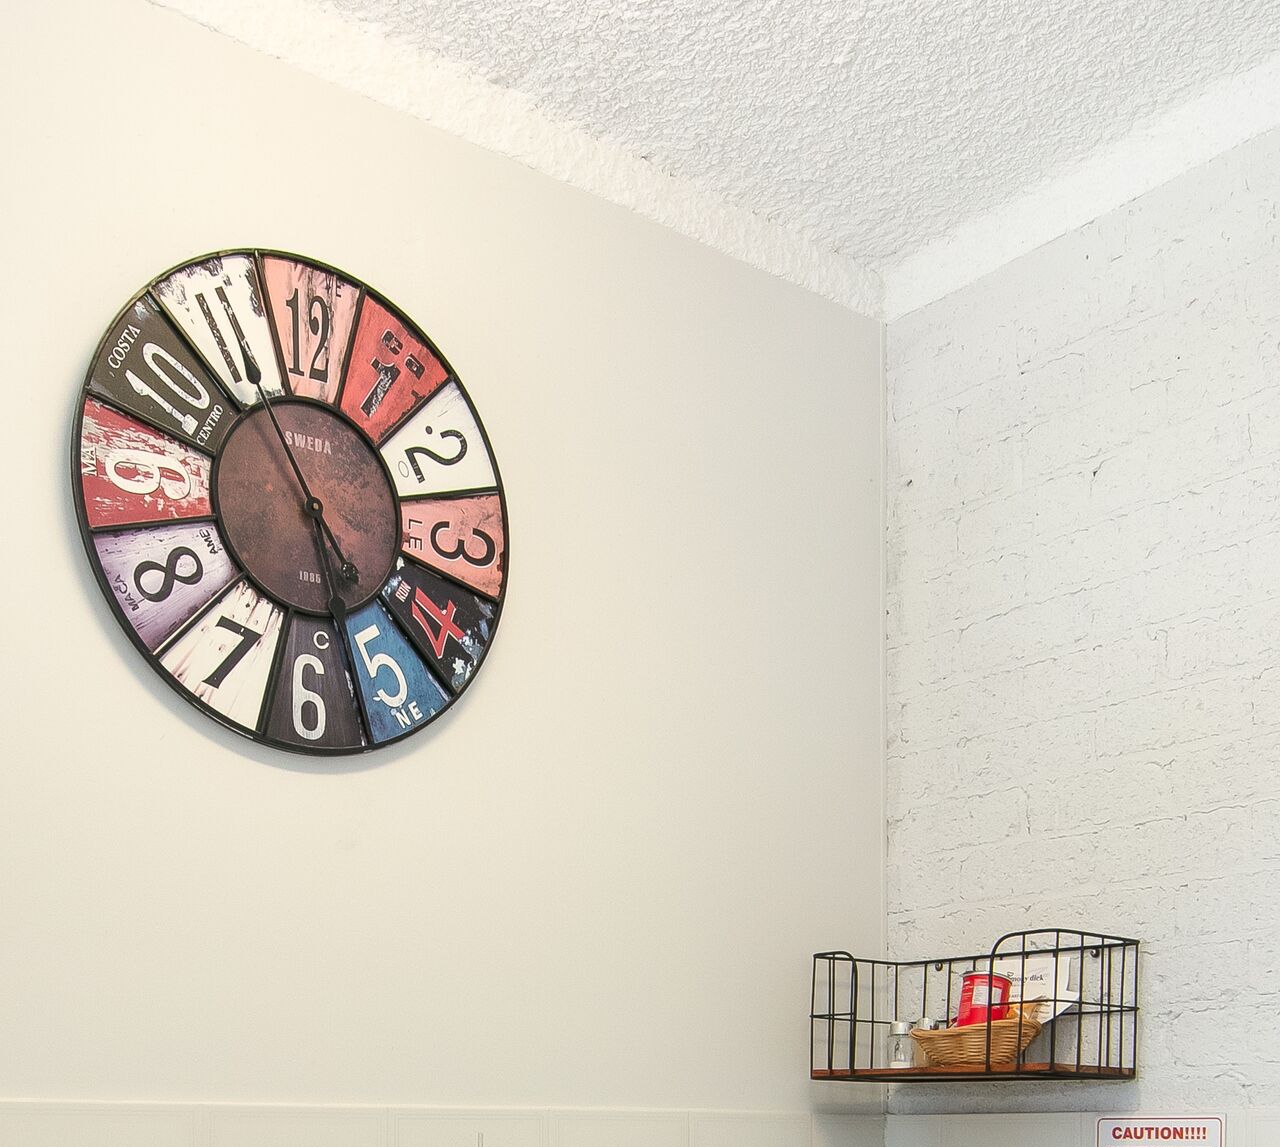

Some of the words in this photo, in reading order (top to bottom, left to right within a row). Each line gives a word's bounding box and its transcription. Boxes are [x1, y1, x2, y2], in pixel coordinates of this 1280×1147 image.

[108, 324, 141, 369] COSTA
[195, 286, 260, 383] 11
[285, 288, 330, 383] 12
[125, 342, 210, 436] 10
[361, 357, 401, 418] 1
[196, 405, 223, 446] CENTRO
[285, 431, 332, 455] SWEDA
[105, 448, 192, 500] 9
[404, 429, 468, 484] 2
[409, 518, 423, 551] LE
[430, 521, 496, 567] 3
[133, 546, 204, 603] 8
[313, 631, 330, 650] C
[412, 586, 465, 659] 4
[202, 613, 264, 690] 7
[354, 623, 408, 708] 5
[292, 654, 326, 740] 6
[394, 701, 423, 729] NE
[1112, 1127, 1207, 1139] CAUTION!!!!
